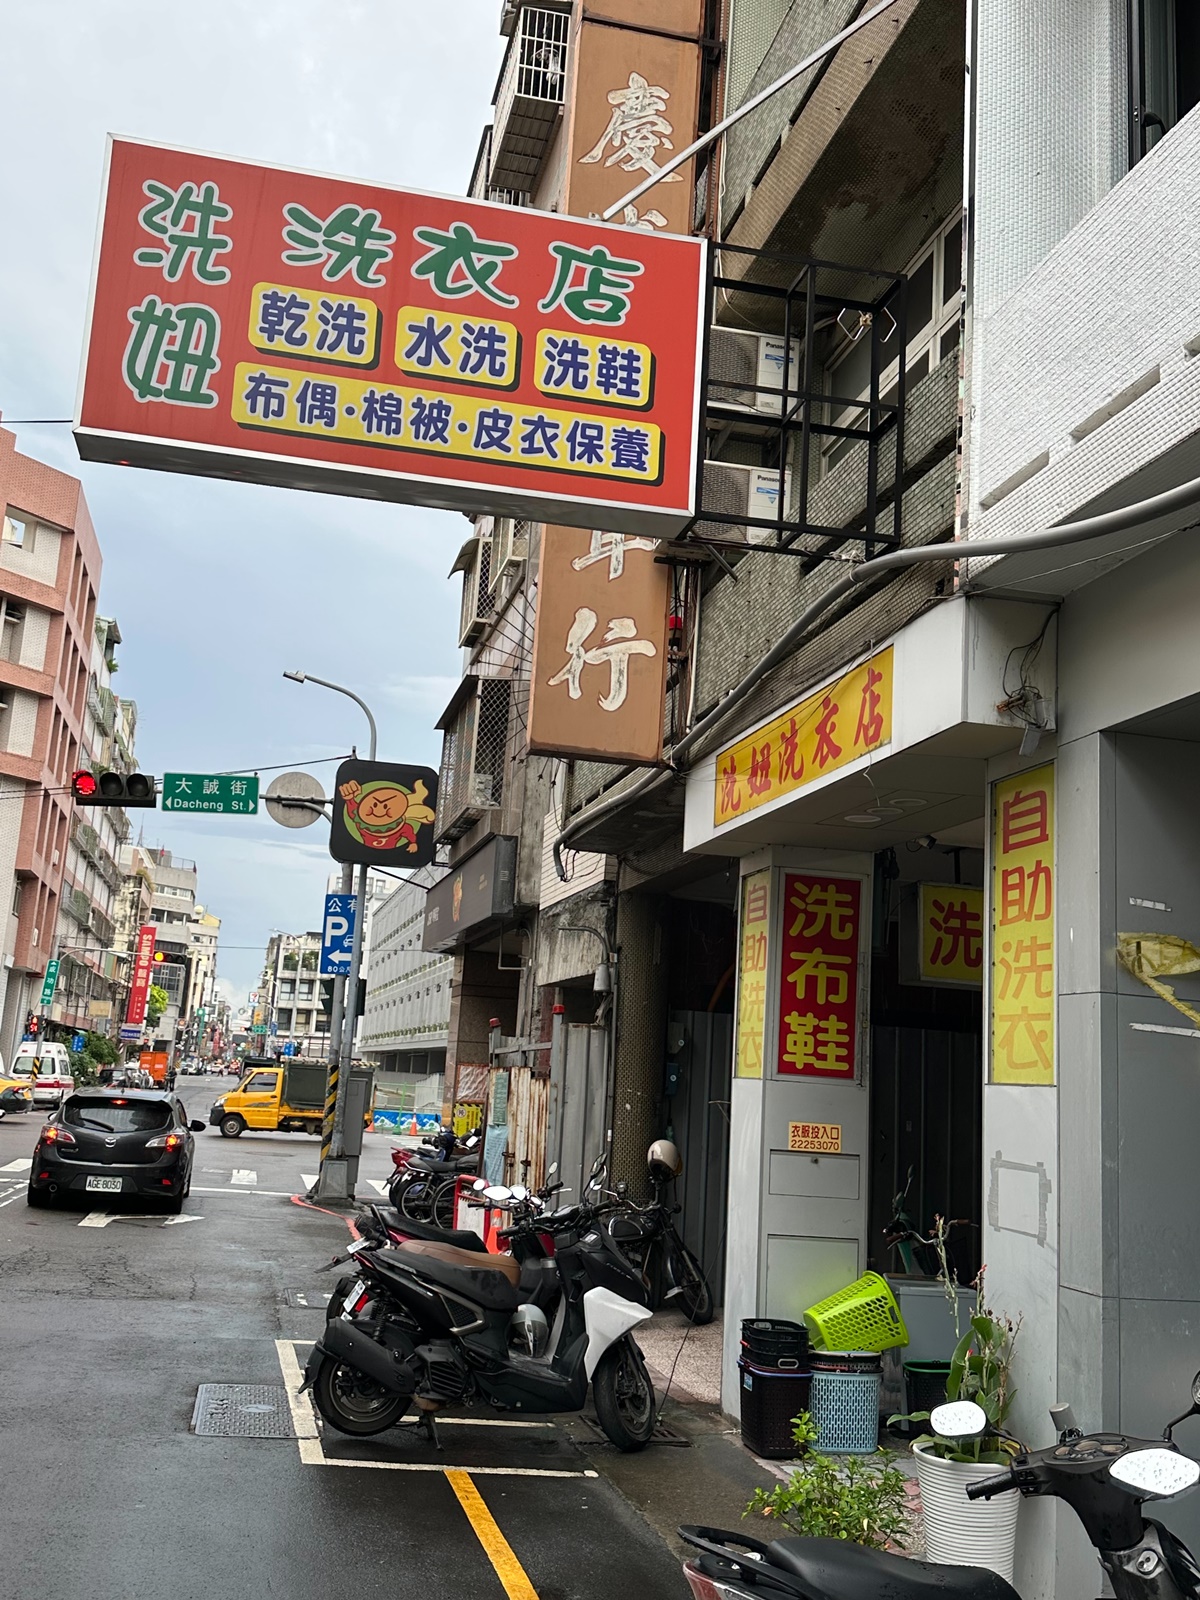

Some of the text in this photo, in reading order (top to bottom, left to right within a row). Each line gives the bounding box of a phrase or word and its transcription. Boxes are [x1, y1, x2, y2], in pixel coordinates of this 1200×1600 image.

[121, 180, 233, 409] 洗妞
[281, 202, 644, 326] 洗衣店
[258, 289, 367, 356] 乾洗
[403, 316, 508, 379] 水洗
[766, 341, 795, 351] Panasic
[543, 337, 650, 398] 洗鞋
[757, 474, 786, 484] Panaso
[720, 666, 885, 816] 洗妞洗衣店
[173, 798, 247, 811] Dacheng St.
[175, 777, 247, 796] 大誠街
[138, 934, 153, 966] SAMPO
[324, 916, 349, 947] P
[998, 789, 1053, 1071] 自助洗衣
[739, 884, 768, 1068] 自助洗衣
[782, 881, 853, 1071] 洗布鞋
[791, 1125, 840, 1140] 衣服投入口
[791, 1139, 840, 1151] 22253070
